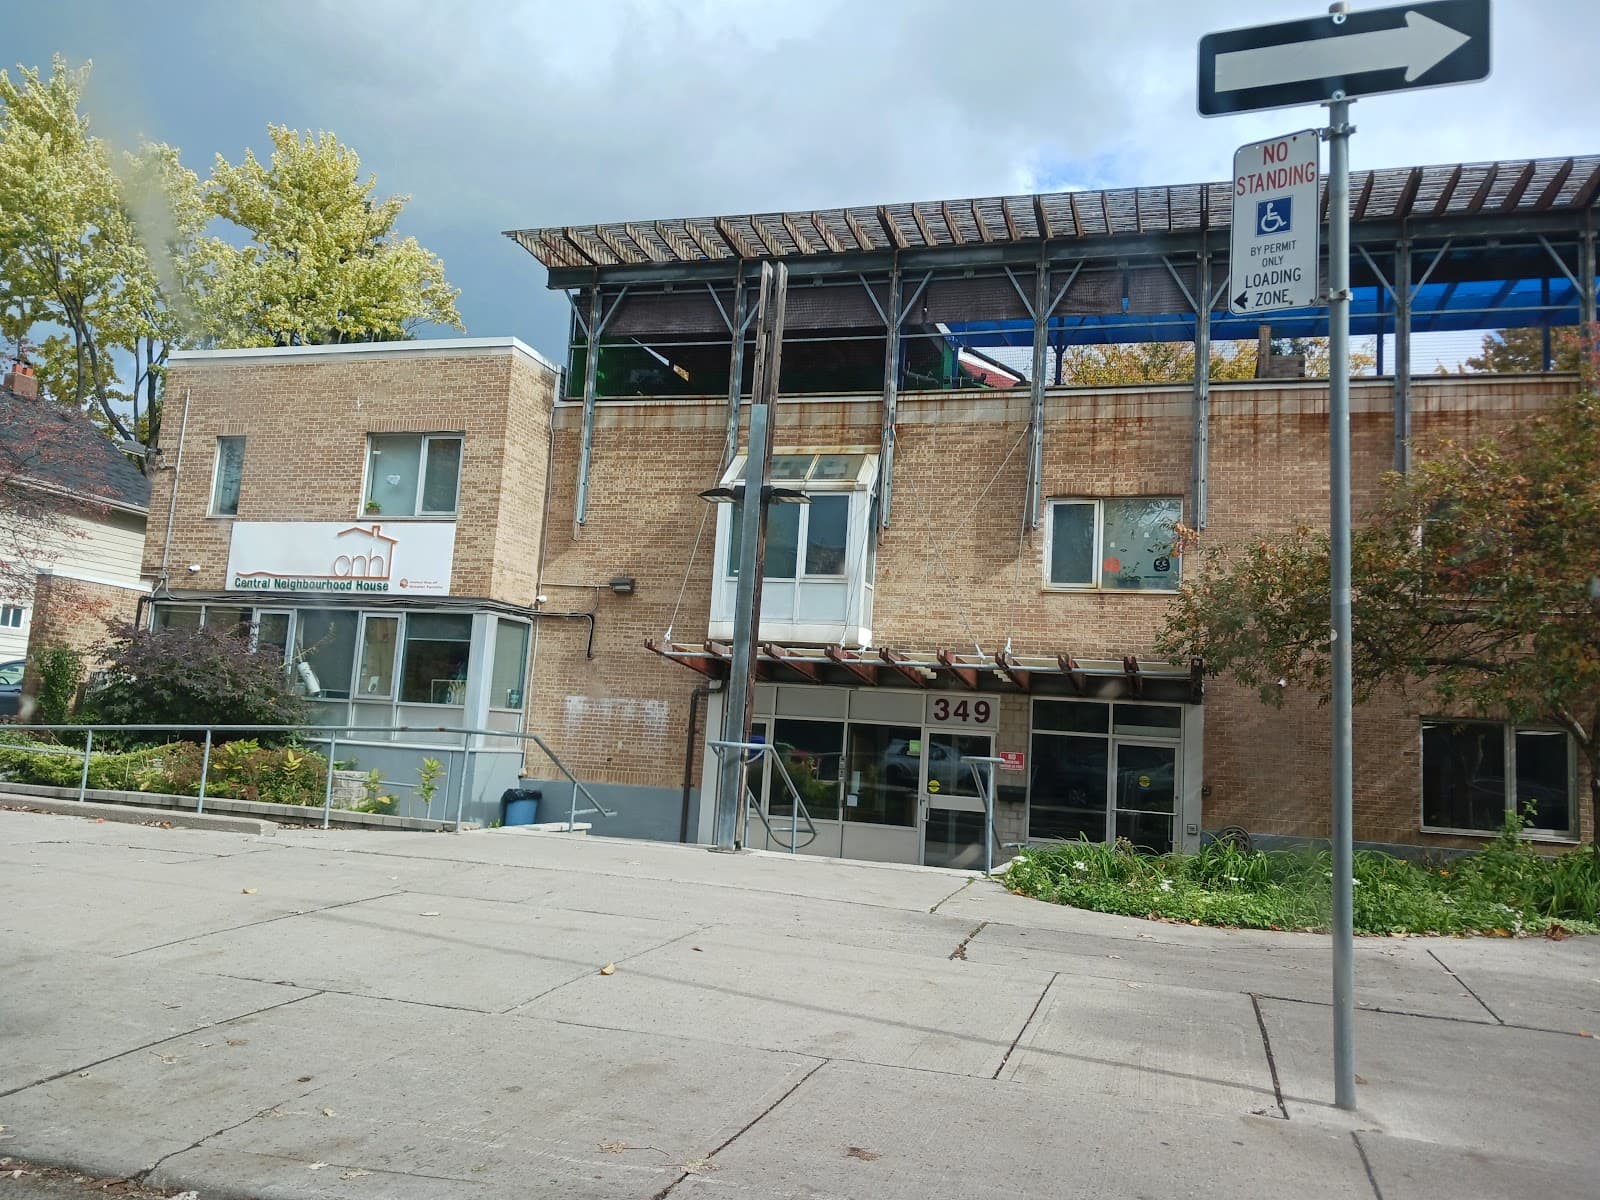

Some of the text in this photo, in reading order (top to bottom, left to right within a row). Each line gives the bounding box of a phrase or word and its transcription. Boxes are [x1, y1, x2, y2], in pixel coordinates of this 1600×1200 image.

[1263, 141, 1288, 165] NO
[1236, 162, 1315, 196] STANDING
[1250, 240, 1297, 257] BY PERMIT
[1262, 256, 1284, 268] ONLY
[1245, 267, 1301, 288] LOADING
[1255, 289, 1289, 307] ZONE
[234, 577, 389, 592] Central Neighbourhood House
[933, 698, 991, 723] 349
